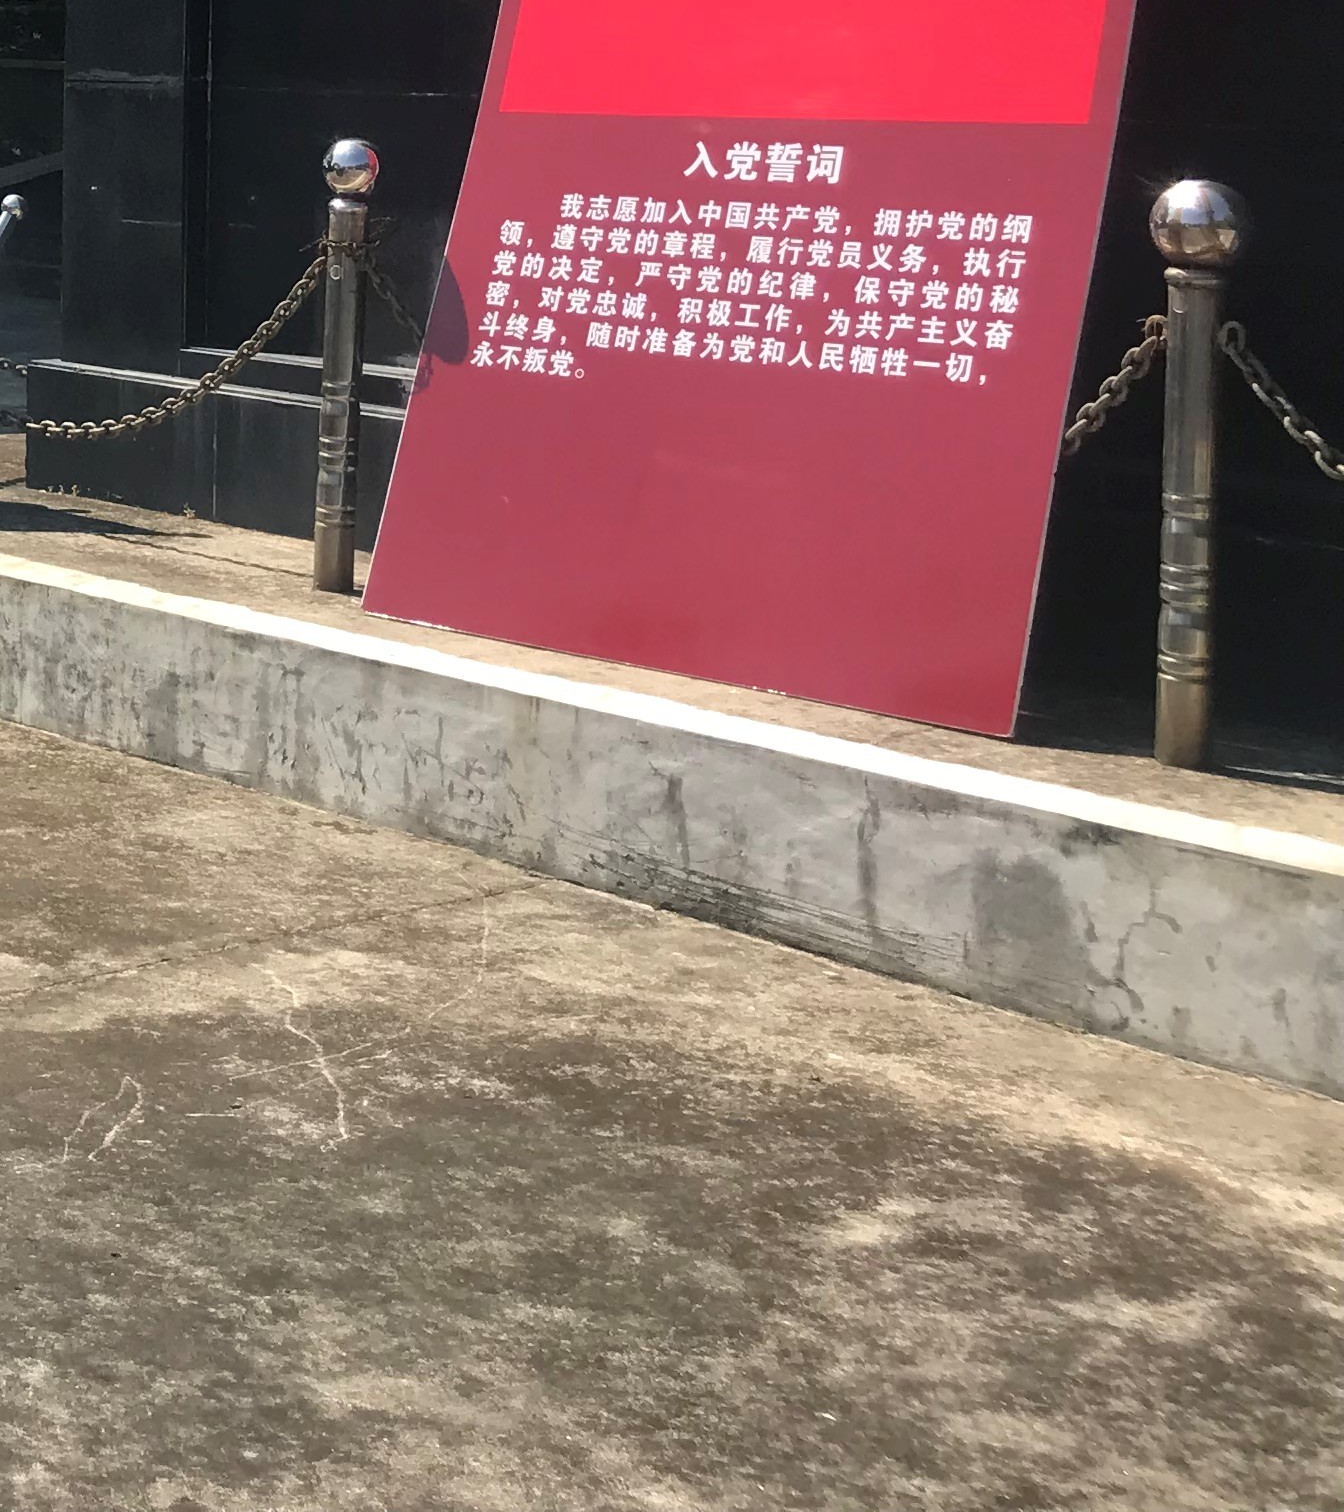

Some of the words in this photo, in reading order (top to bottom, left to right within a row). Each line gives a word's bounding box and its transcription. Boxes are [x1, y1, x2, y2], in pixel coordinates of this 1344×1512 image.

[683, 140, 844, 184] 入党誓词
[560, 193, 1033, 244] 我志愿加入中国共产党，拥护党的纲
[499, 219, 1026, 279] 领，遵守党的章程，履行党员义务，执行
[492, 250, 1019, 314] 党的决定，严守党的纪律，保守党的秘
[485, 281, 1014, 350] 密，对党忠诚，积极工作，为共产主义奋
[470, 341, 585, 380] 永不叛党。
[478, 312, 987, 385] 斗终身，随时准备为党和人民牺牲一切，
